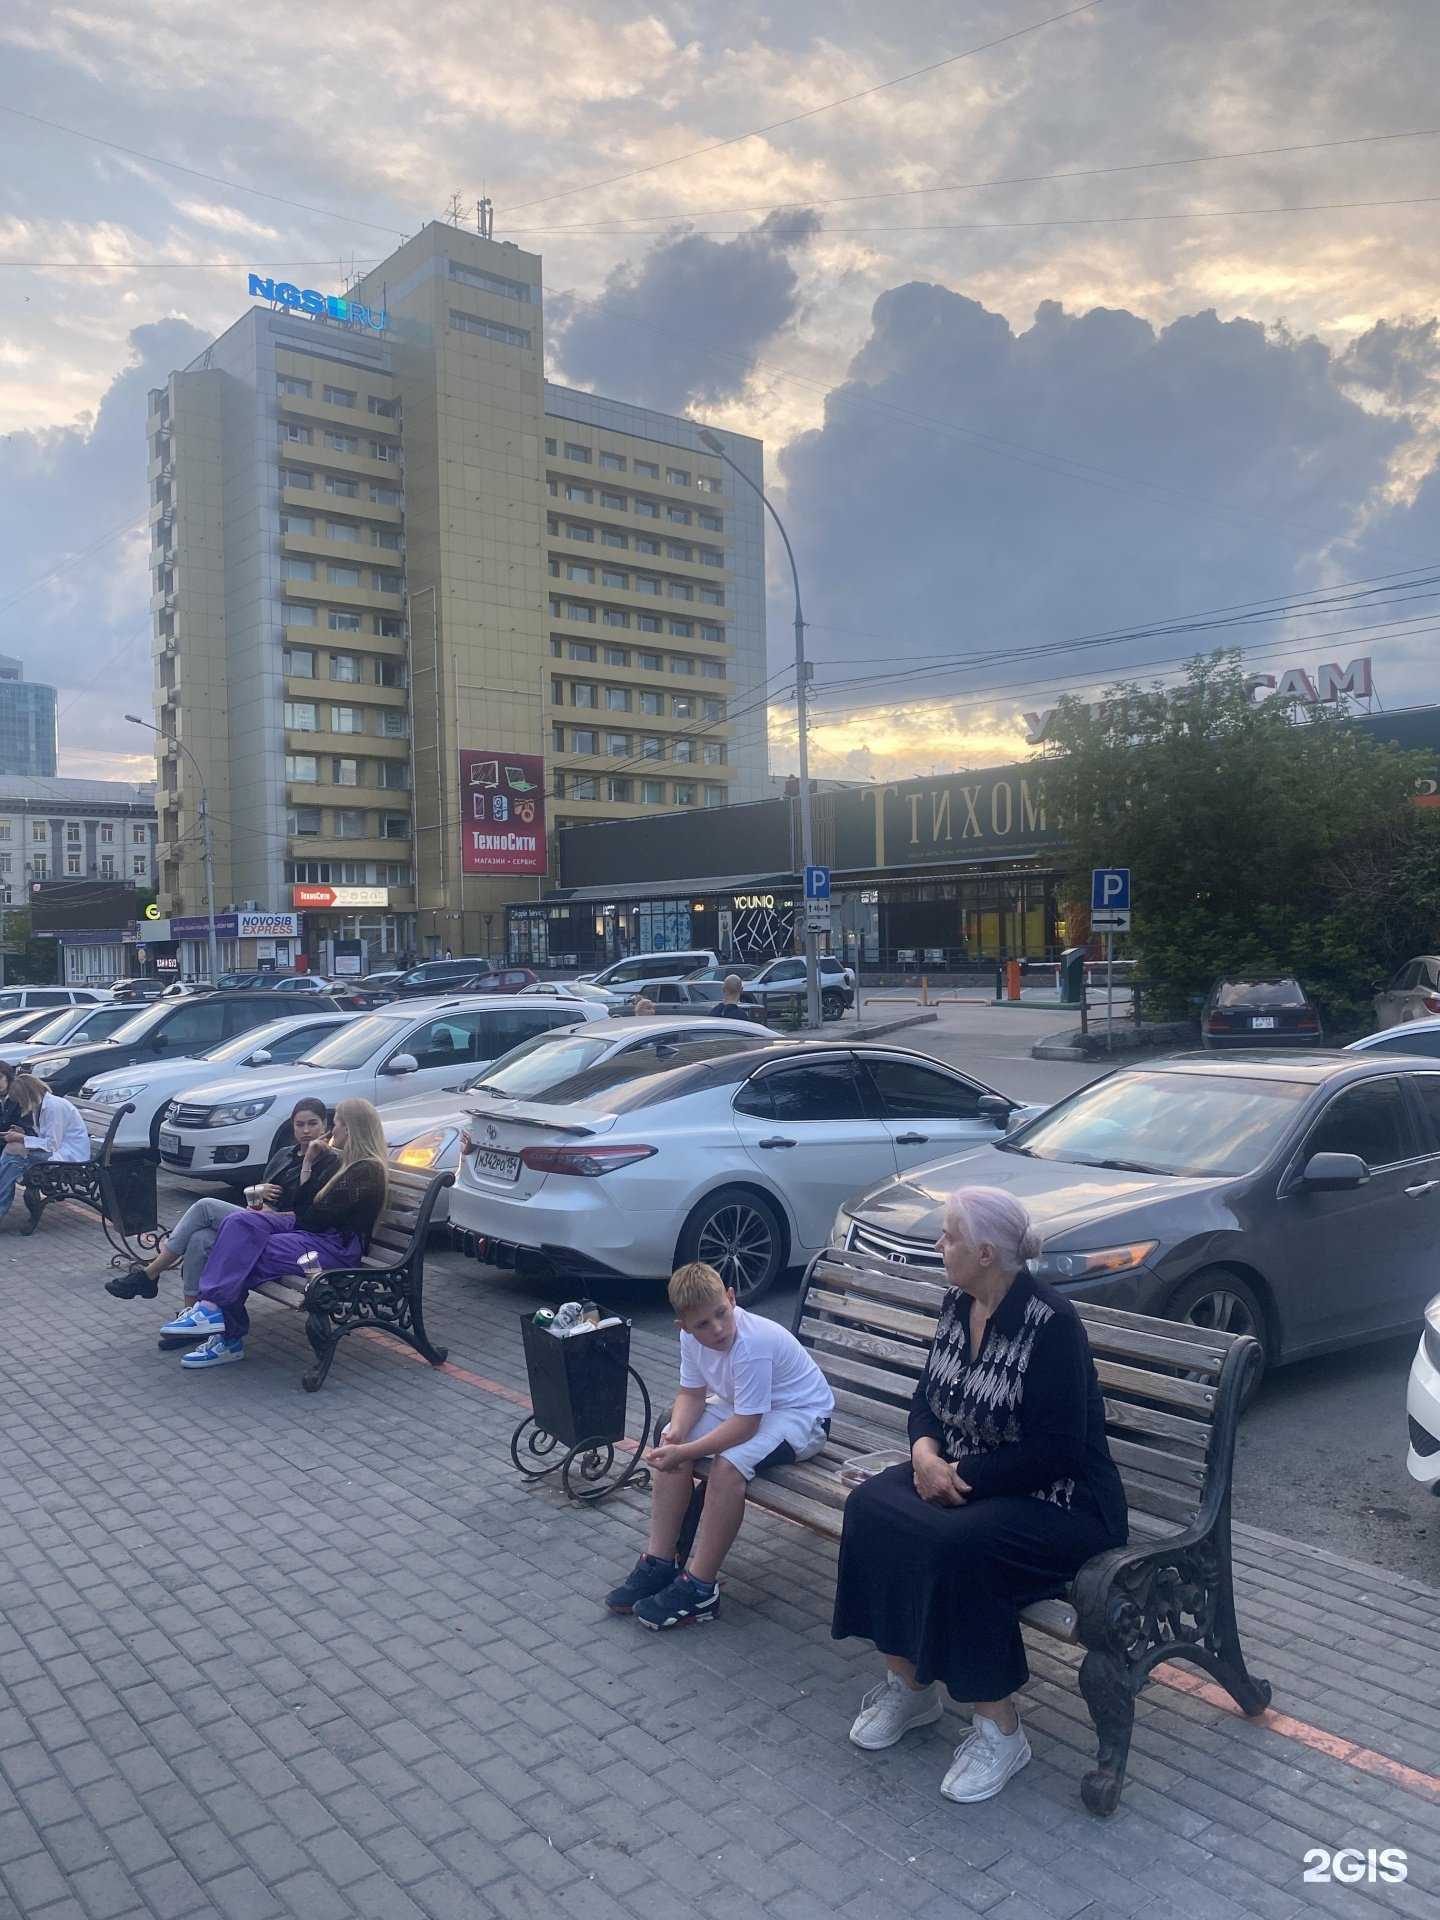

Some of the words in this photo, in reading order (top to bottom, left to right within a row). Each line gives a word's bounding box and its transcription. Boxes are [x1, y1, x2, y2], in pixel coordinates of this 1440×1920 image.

[248, 272, 324, 315] NGS
[472, 831, 536, 851] ТехноСити
[512, 858, 537, 866] СЕРВИС
[242, 916, 292, 926] NOVOSIB
[243, 925, 293, 935] EXPRESS
